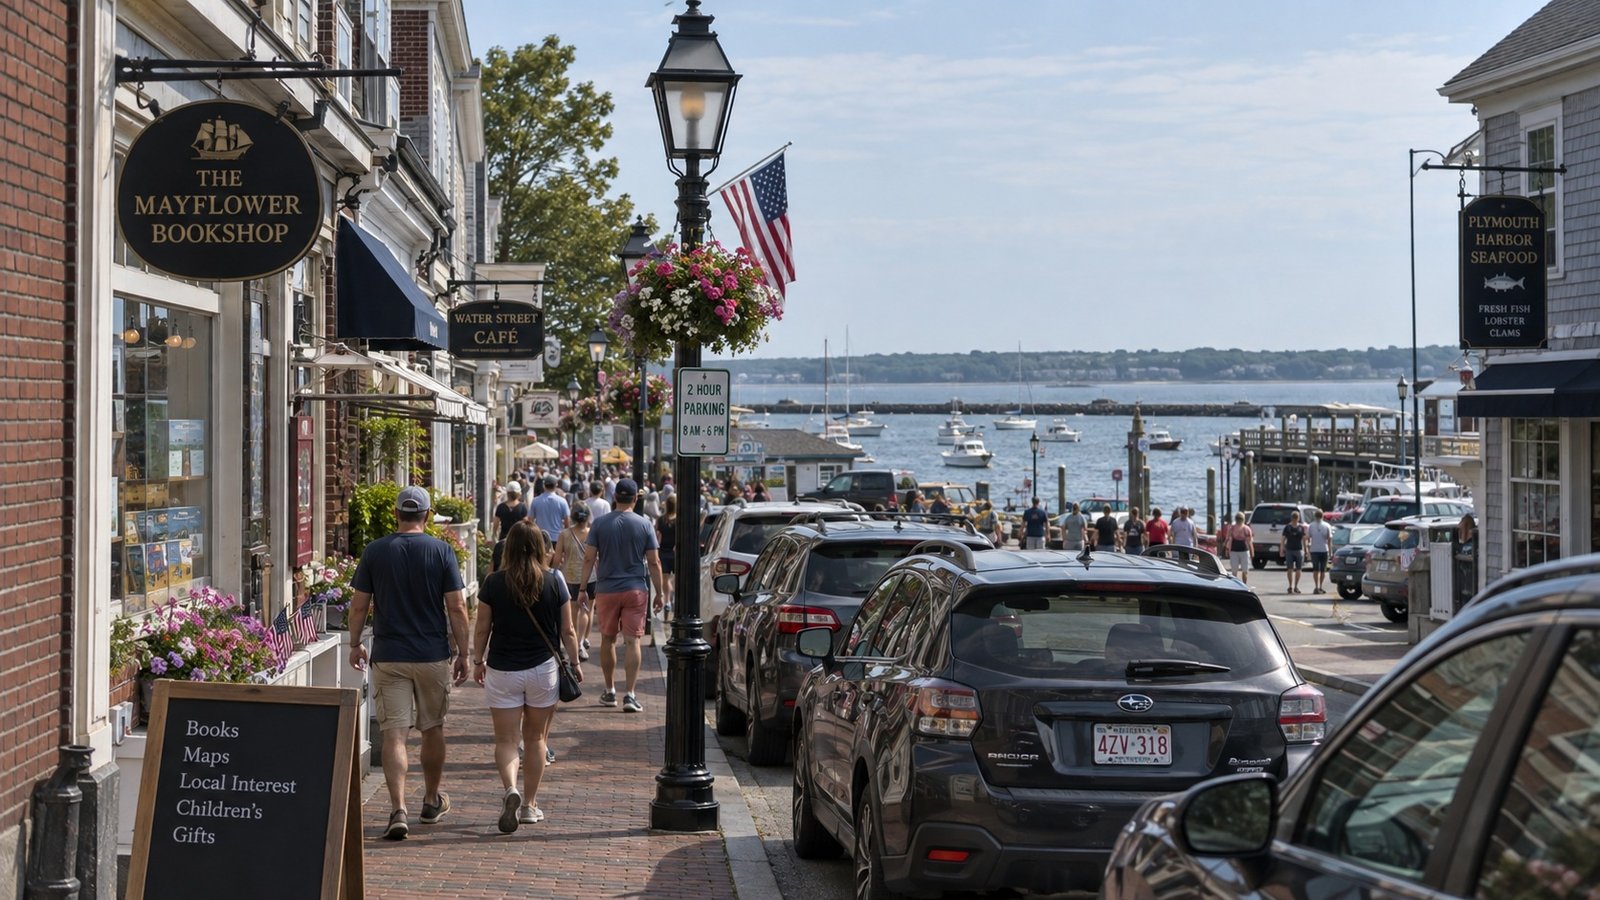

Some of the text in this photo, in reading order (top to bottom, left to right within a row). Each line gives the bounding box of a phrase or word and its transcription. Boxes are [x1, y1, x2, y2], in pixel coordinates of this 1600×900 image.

[196, 170, 243, 187] THE
[134, 195, 302, 215] MAYFLOWER
[1468, 216, 1539, 229] PLYMOUTH
[151, 223, 289, 244] BOOKSHOP
[1476, 233, 1533, 246] HARBOR
[1470, 251, 1538, 264] SEAFOOD
[1478, 304, 1531, 313] FRESH FISH
[455, 313, 538, 324] WATER STREET
[1484, 316, 1525, 325] LOBSTER
[474, 327, 519, 344] CAFÉ
[1489, 328, 1521, 337] CLAMS
[687, 384, 722, 396] 2 HOUR
[684, 402, 725, 416] PARKING
[682, 425, 689, 436] 8
[689, 426, 701, 437] AM
[706, 426, 712, 437] 6
[713, 426, 725, 437] PM
[186, 720, 239, 738] Books
[1098, 735, 1168, 755] 4ZV 318
[183, 746, 230, 767] Maps
[179, 772, 297, 794] Local Interest
[176, 799, 263, 820] Children’s
[173, 826, 216, 844] Gifts
